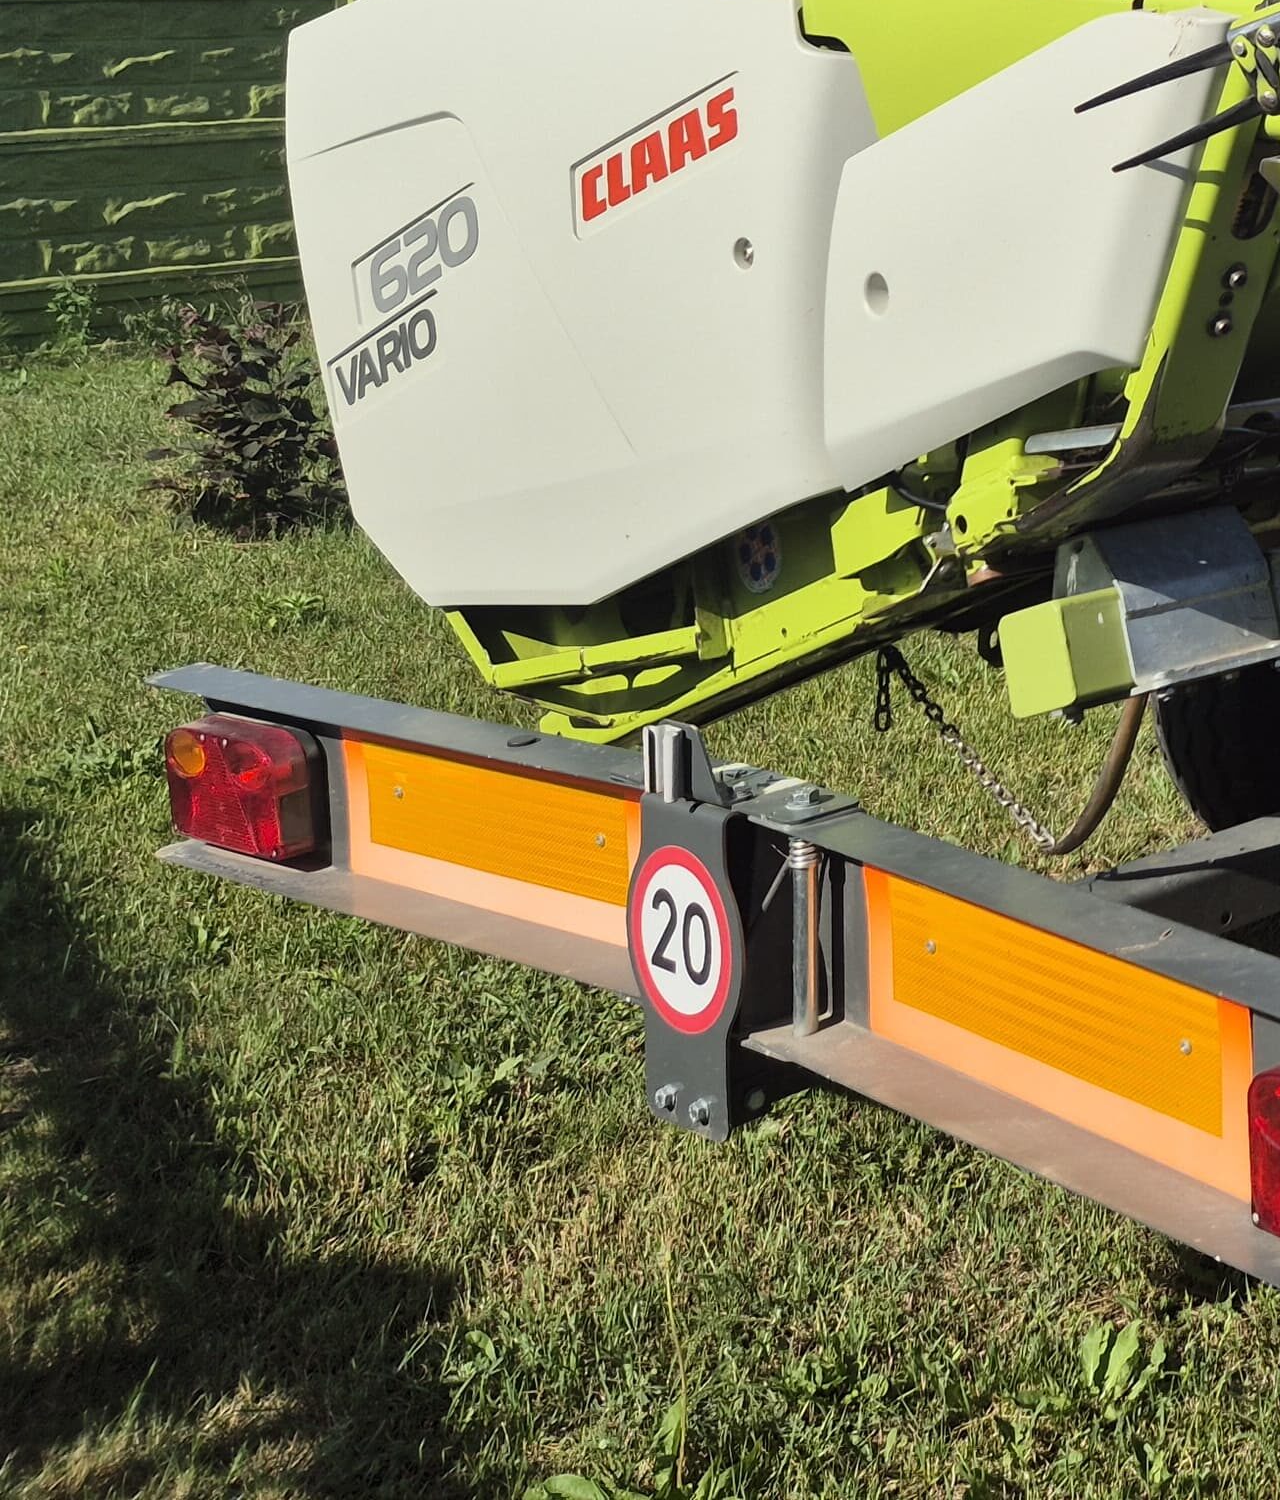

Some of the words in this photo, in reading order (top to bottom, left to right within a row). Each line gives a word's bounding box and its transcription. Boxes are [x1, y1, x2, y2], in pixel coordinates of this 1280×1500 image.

[580, 86, 739, 223] CLAAS
[370, 196, 479, 314] 620
[334, 307, 438, 407] VARIO
[651, 888, 713, 987] 20
